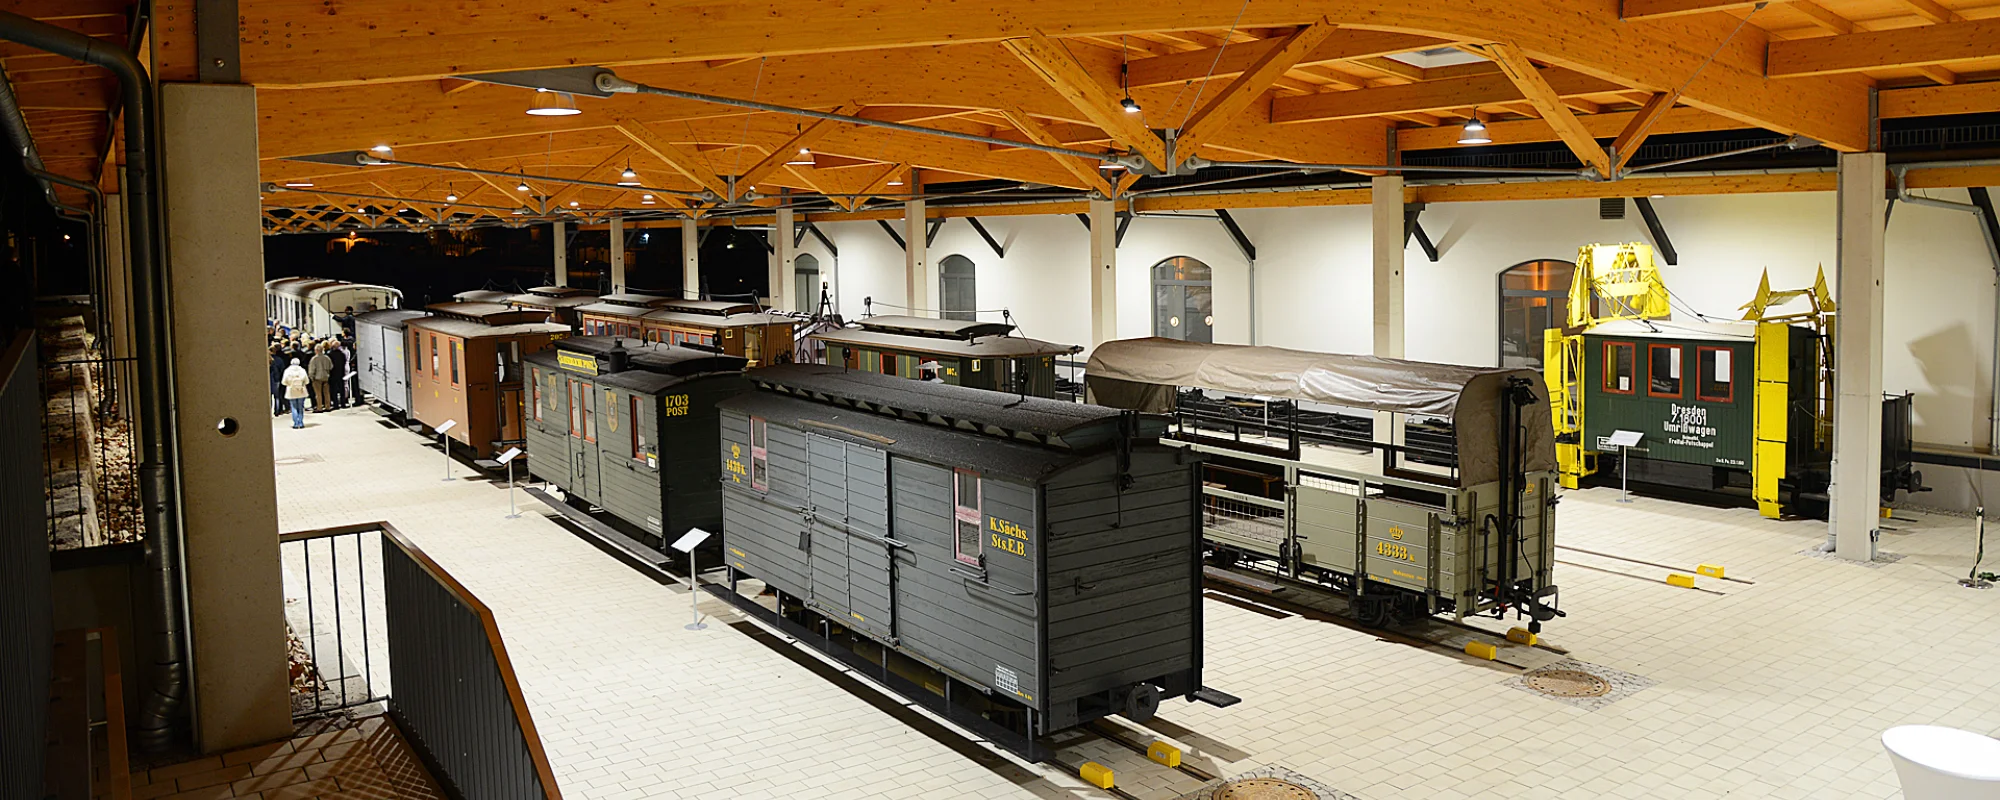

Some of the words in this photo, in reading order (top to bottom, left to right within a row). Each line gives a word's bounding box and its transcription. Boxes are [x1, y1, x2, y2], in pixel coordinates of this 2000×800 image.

[665, 394, 689, 408] 1703
[666, 405, 689, 417] POST
[1671, 403, 1707, 416] Dresden
[1663, 420, 1717, 437] Umrißwagen
[1376, 541, 1408, 561] 4333
